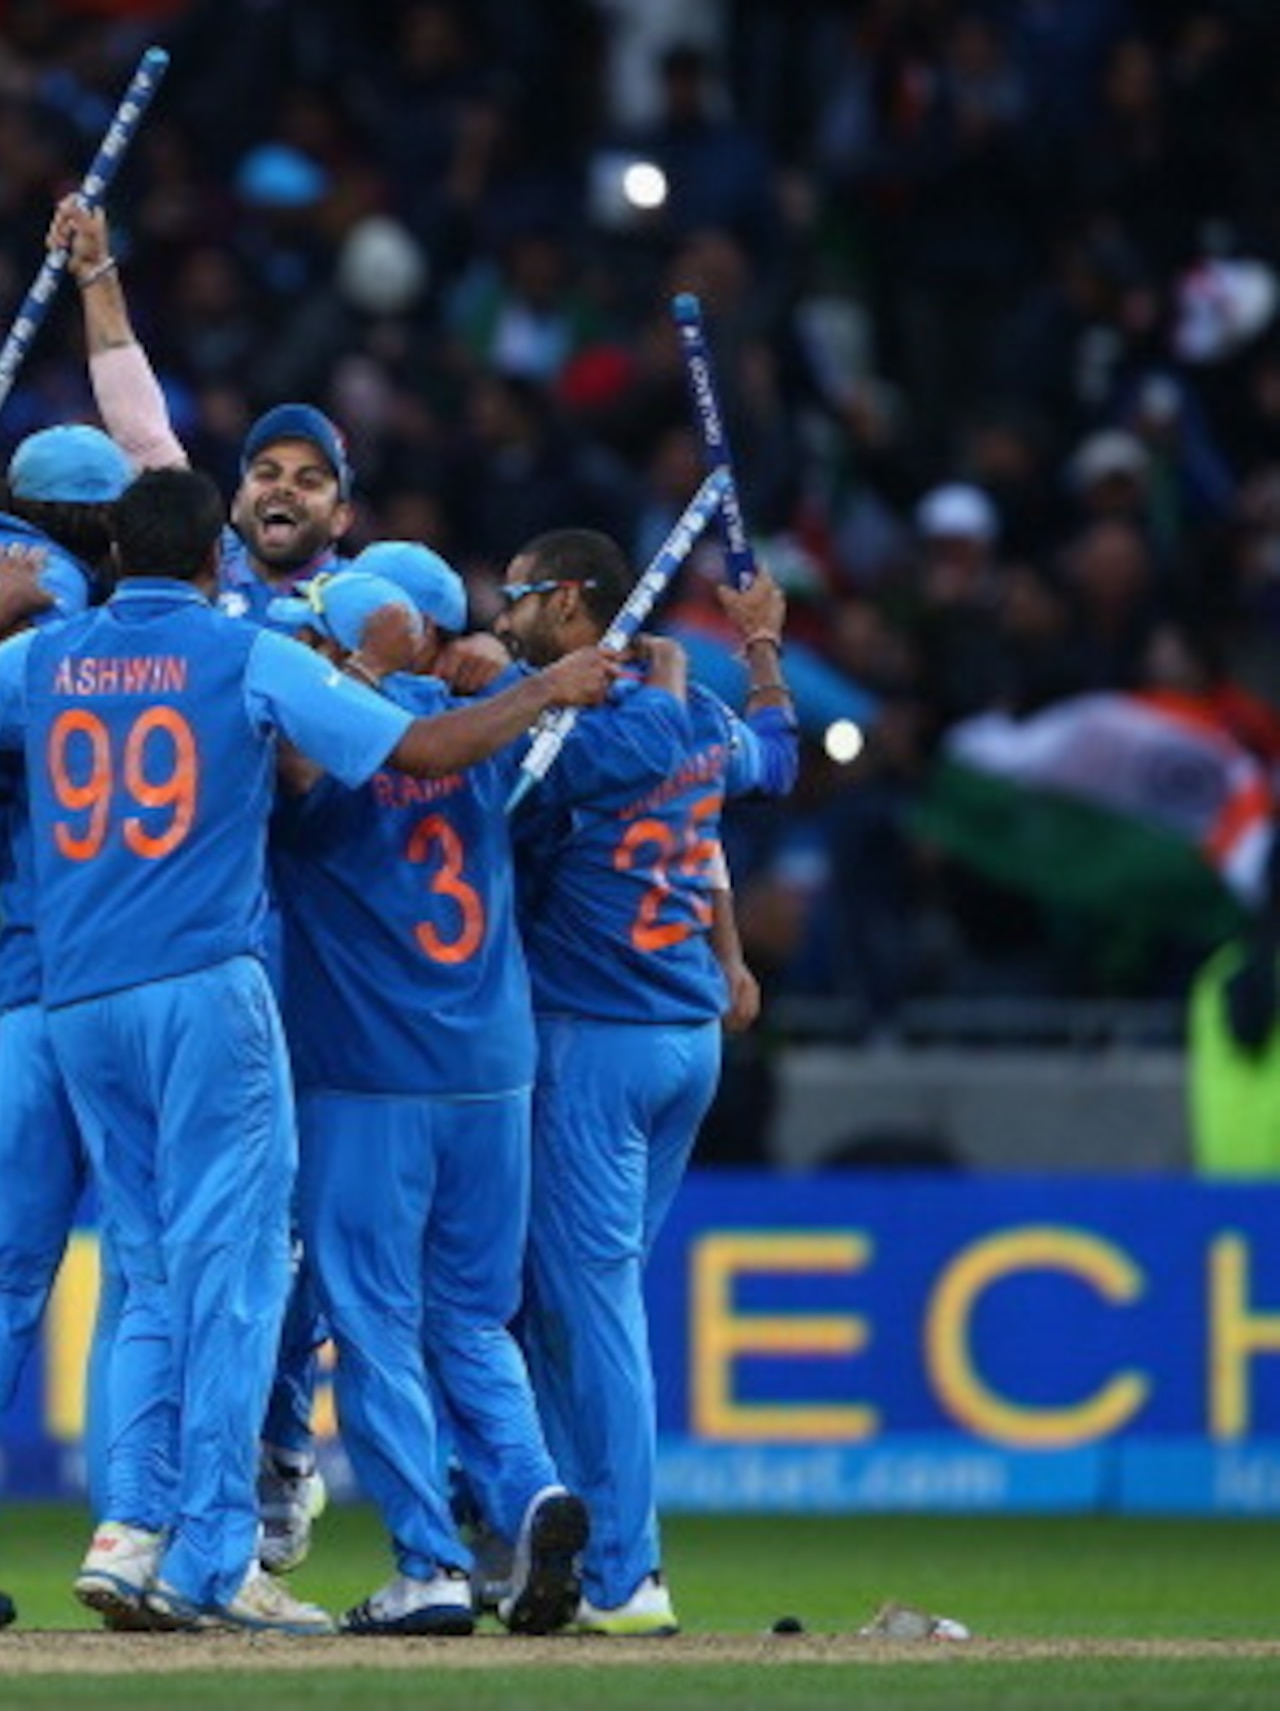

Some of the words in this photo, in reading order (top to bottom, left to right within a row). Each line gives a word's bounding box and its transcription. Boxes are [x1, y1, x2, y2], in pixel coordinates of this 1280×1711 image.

[55, 654, 188, 695] ASHWIN
[47, 704, 198, 860] 99
[405, 813, 487, 964] 3
